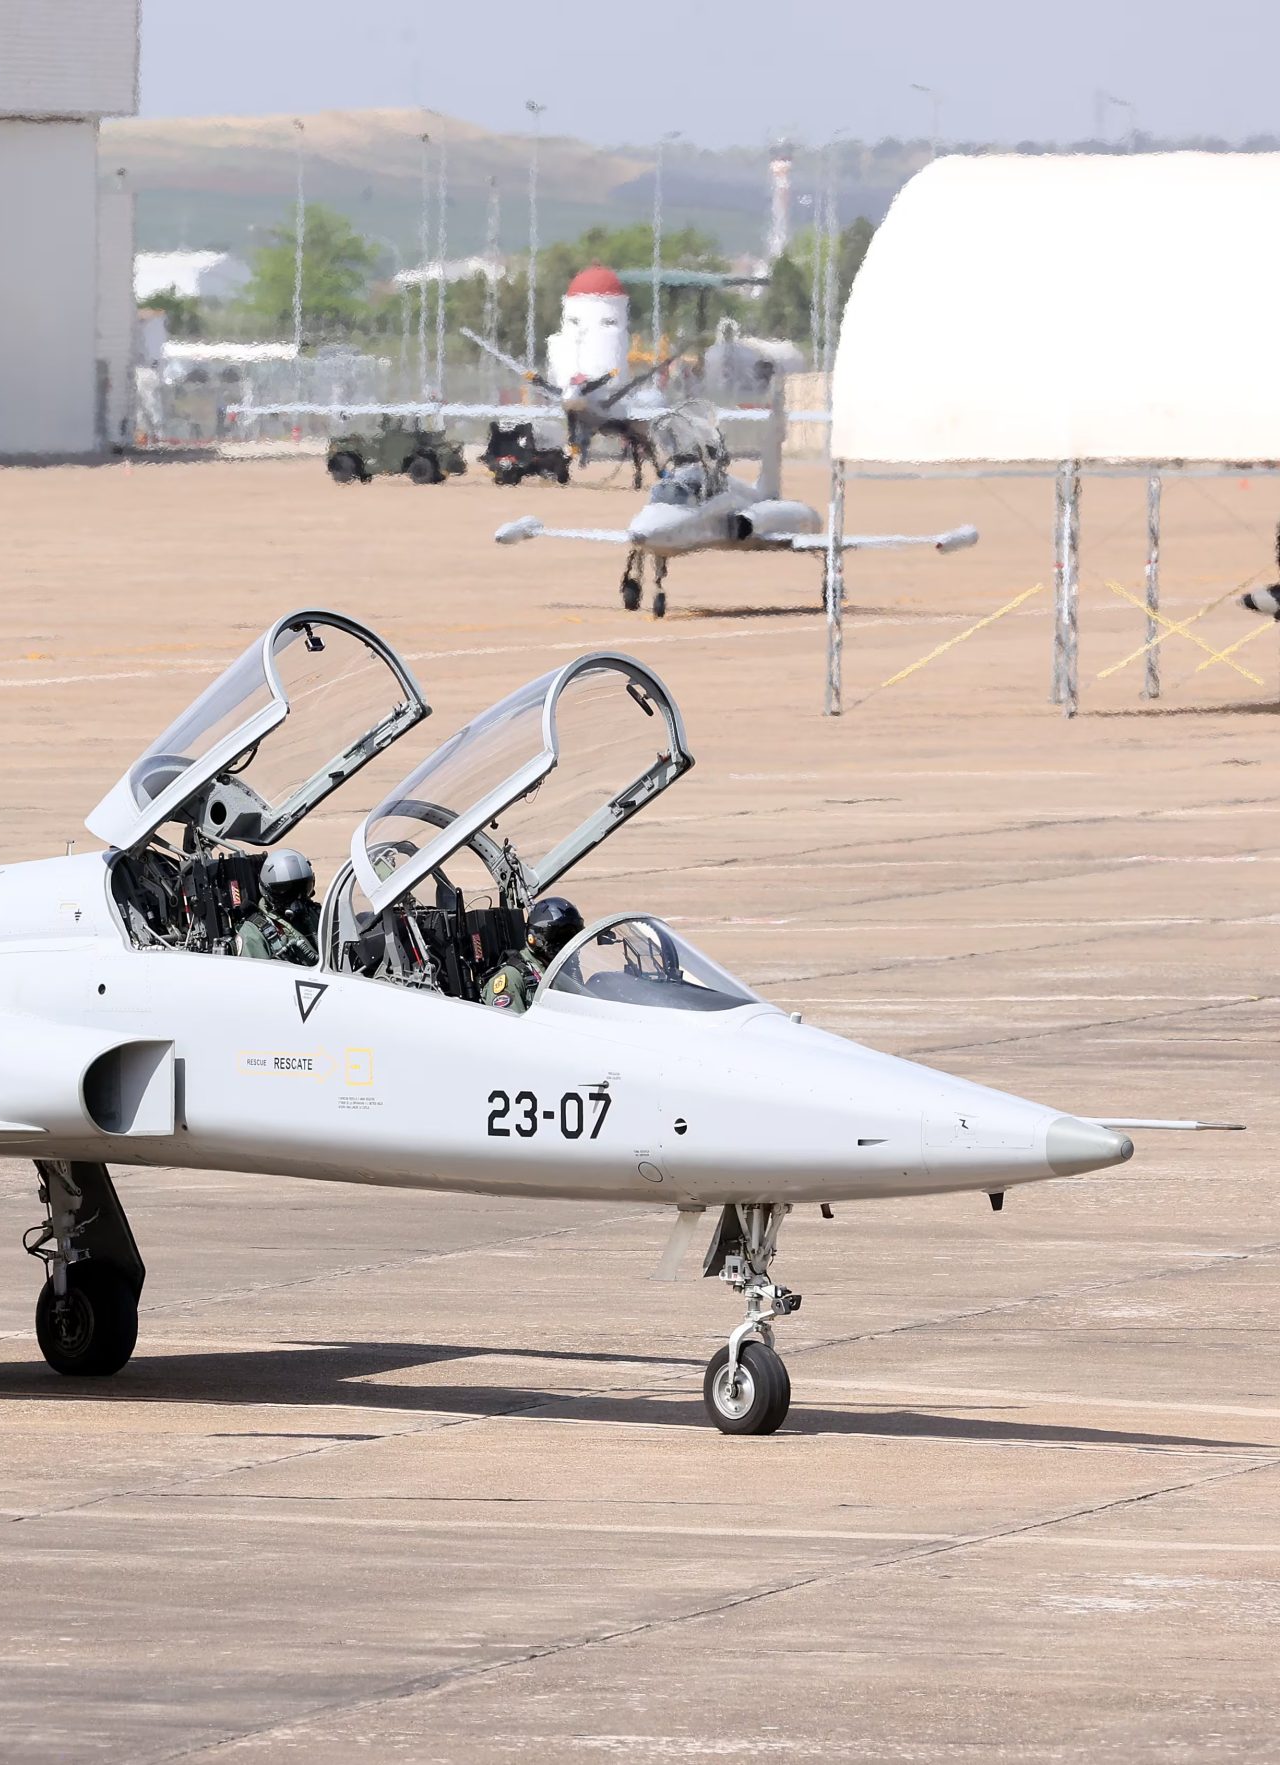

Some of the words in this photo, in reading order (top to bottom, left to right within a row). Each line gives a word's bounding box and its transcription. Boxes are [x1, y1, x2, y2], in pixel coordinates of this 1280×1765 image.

[246, 1058, 267, 1067] RESCUE
[273, 1057, 313, 1071] RESCATE
[487, 1090, 612, 1139] 23-07
